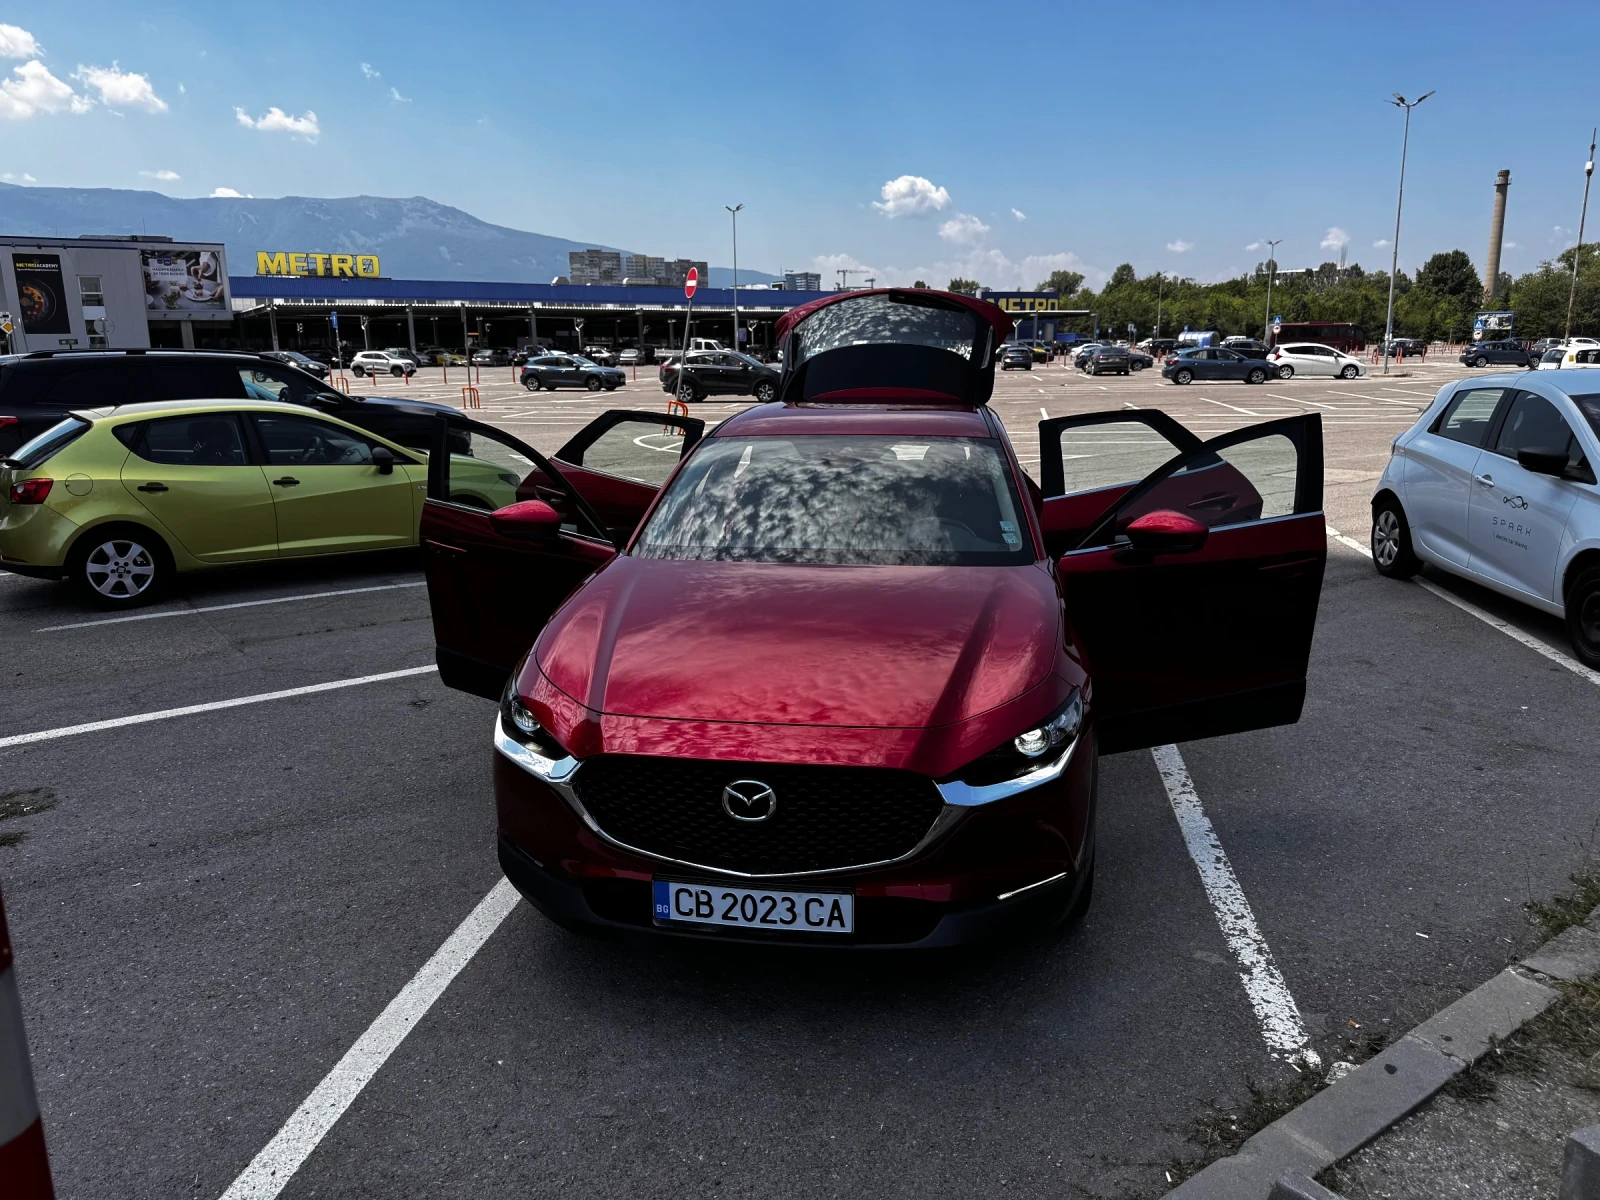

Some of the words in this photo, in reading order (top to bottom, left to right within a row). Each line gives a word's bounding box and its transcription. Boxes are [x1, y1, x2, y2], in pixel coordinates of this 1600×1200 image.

[257, 251, 380, 278] METRO
[1492, 516, 1531, 537] SPARK
[656, 904, 669, 913] BG
[675, 887, 714, 918] CB
[721, 892, 798, 925] 2023
[804, 897, 846, 928] CA
